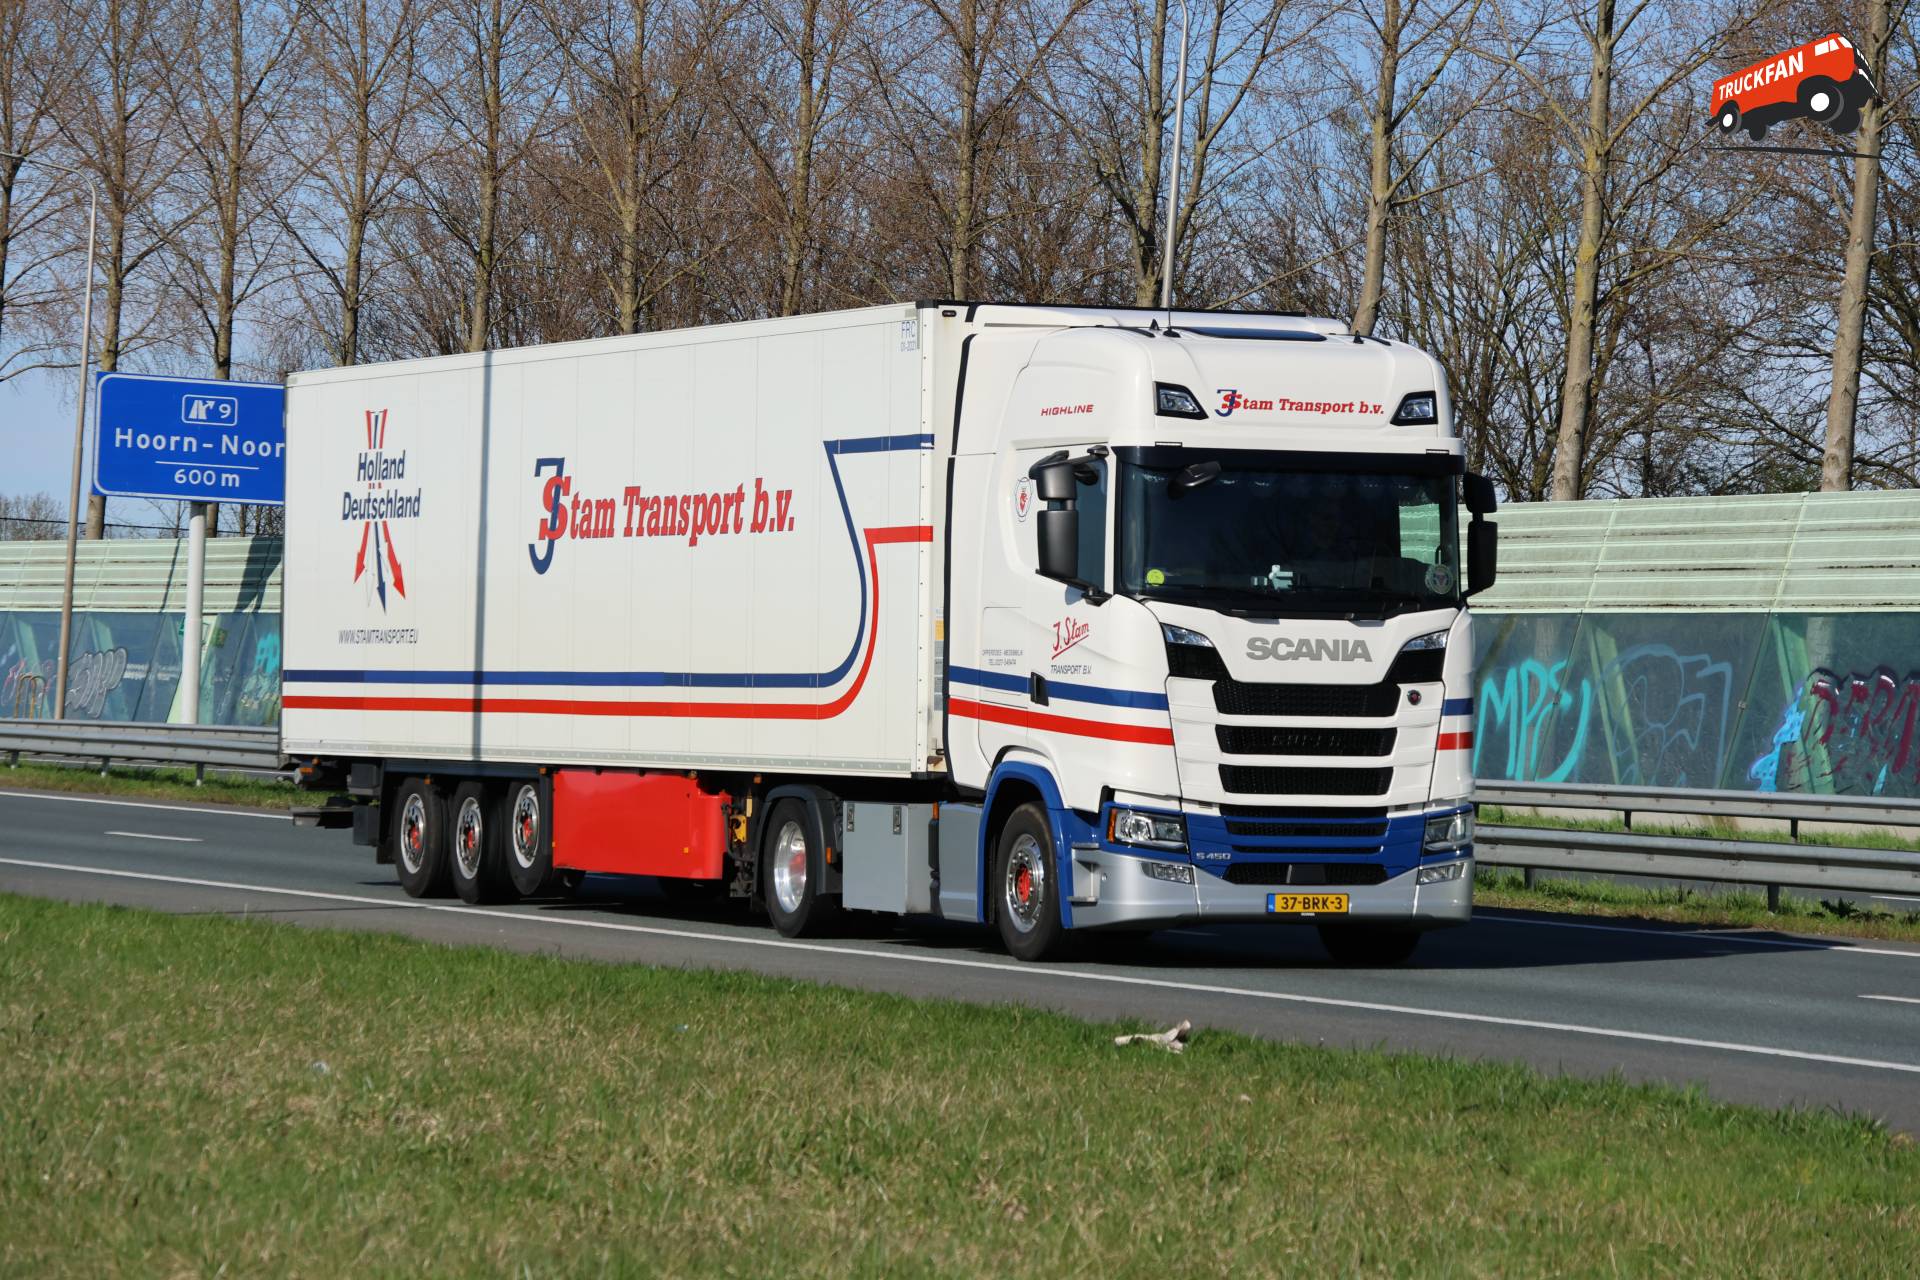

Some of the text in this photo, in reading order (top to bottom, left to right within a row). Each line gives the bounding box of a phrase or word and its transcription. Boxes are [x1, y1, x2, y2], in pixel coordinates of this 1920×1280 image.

[219, 403, 232, 419] 9
[1040, 404, 1094, 416] HIGHLINE
[1279, 398, 1355, 415] Transport
[1359, 401, 1384, 414] b.v.
[115, 427, 285, 458] Hoorn-Noor
[357, 450, 406, 482] Holland
[174, 468, 240, 487] 600 m
[342, 488, 421, 521] Deutschland
[623, 483, 745, 547] Transport
[750, 477, 795, 533] b.v.
[338, 629, 419, 644] WWW.STAMTRANSPORT.EU
[1064, 617, 1089, 646] Stam
[1246, 636, 1373, 662] SCANIA
[1050, 664, 1081, 675] TRANSPORT
[1206, 852, 1231, 860] 450
[1281, 896, 1343, 911] 37-BRK-3
